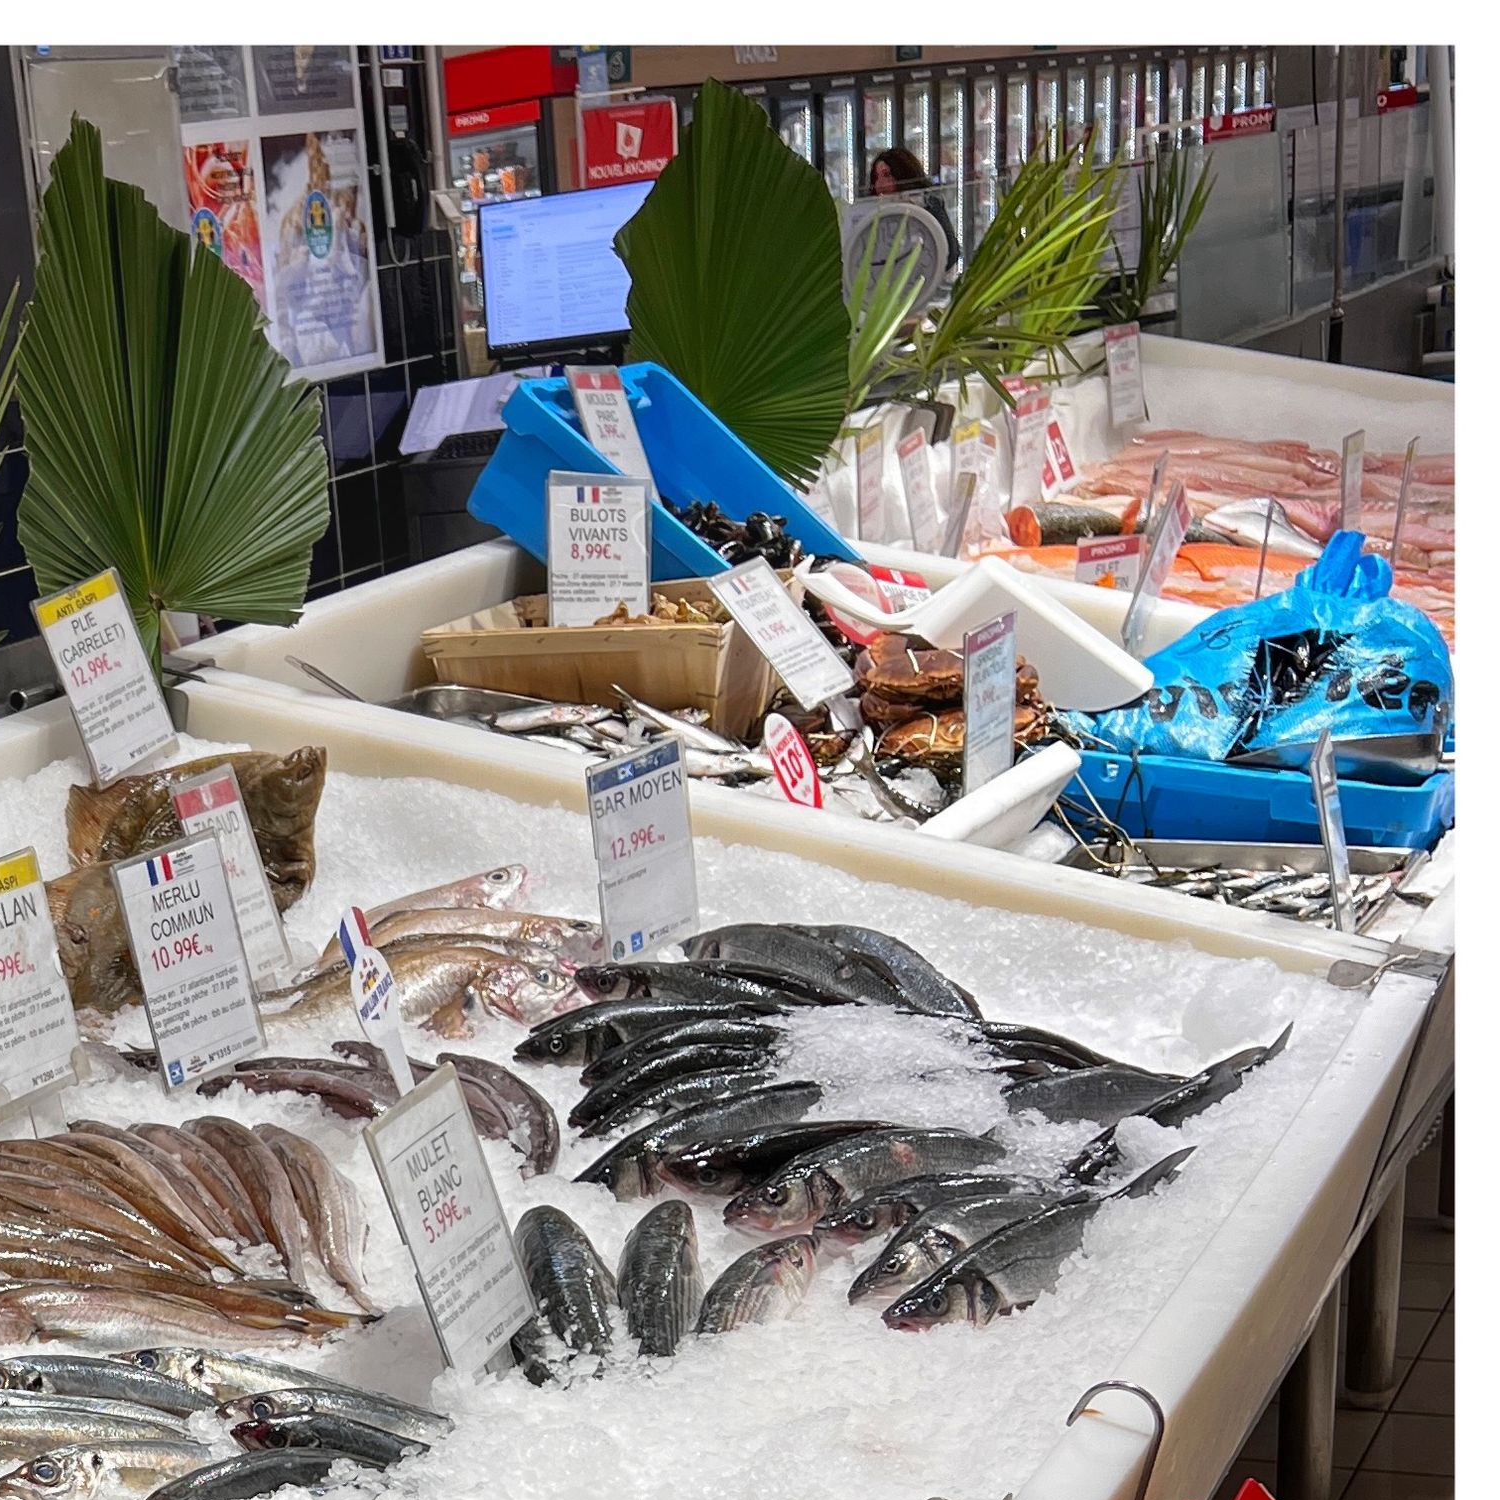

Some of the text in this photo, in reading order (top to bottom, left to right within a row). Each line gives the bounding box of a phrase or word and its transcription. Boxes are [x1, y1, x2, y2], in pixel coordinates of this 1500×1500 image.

[1232, 111, 1273, 129] PROM
[570, 508, 627, 523] BULOTS
[569, 527, 628, 542] VIVANTS
[571, 543, 612, 563] 8,99€
[56, 602, 75, 620] ANTI
[75, 592, 98, 612] GASPI
[71, 611, 98, 636] PLIE
[60, 622, 126, 670] (CARRELET)
[71, 652, 113, 688] 12,99€
[594, 767, 682, 820] BAR MOYEN
[611, 824, 656, 860] 12,99€
[152, 880, 201, 914] MERLU
[151, 902, 214, 941] COMMUN
[151, 933, 202, 971] 10.99€
[406, 1131, 452, 1181] MULET
[418, 1164, 462, 1213] BLANC
[423, 1195, 462, 1243] 5.99€
